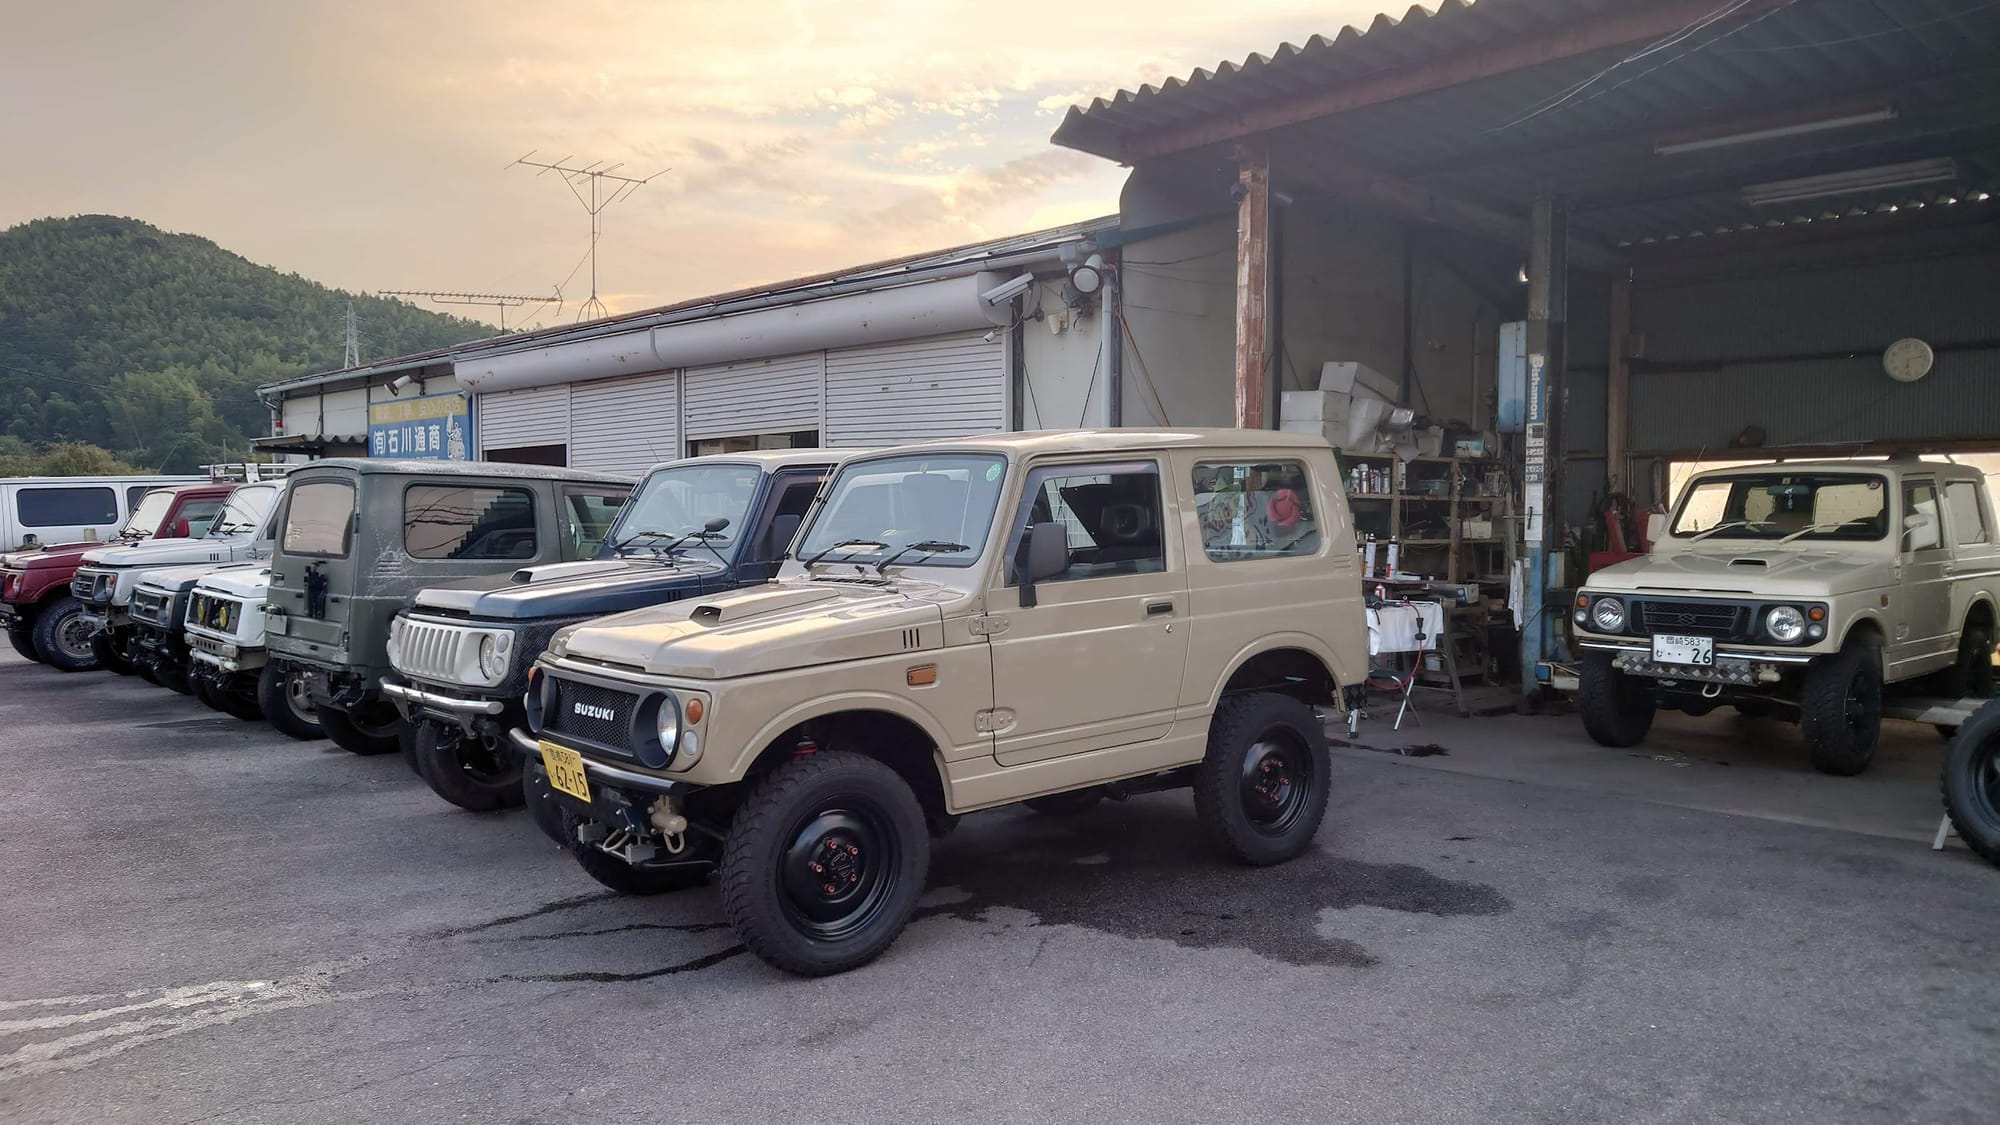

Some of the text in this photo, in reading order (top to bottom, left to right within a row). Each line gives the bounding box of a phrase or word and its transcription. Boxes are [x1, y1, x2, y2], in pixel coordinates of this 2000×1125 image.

[1691, 648, 1711, 664] 26
[574, 702, 614, 721] SUZUKI
[556, 764, 588, 797] 62-15
